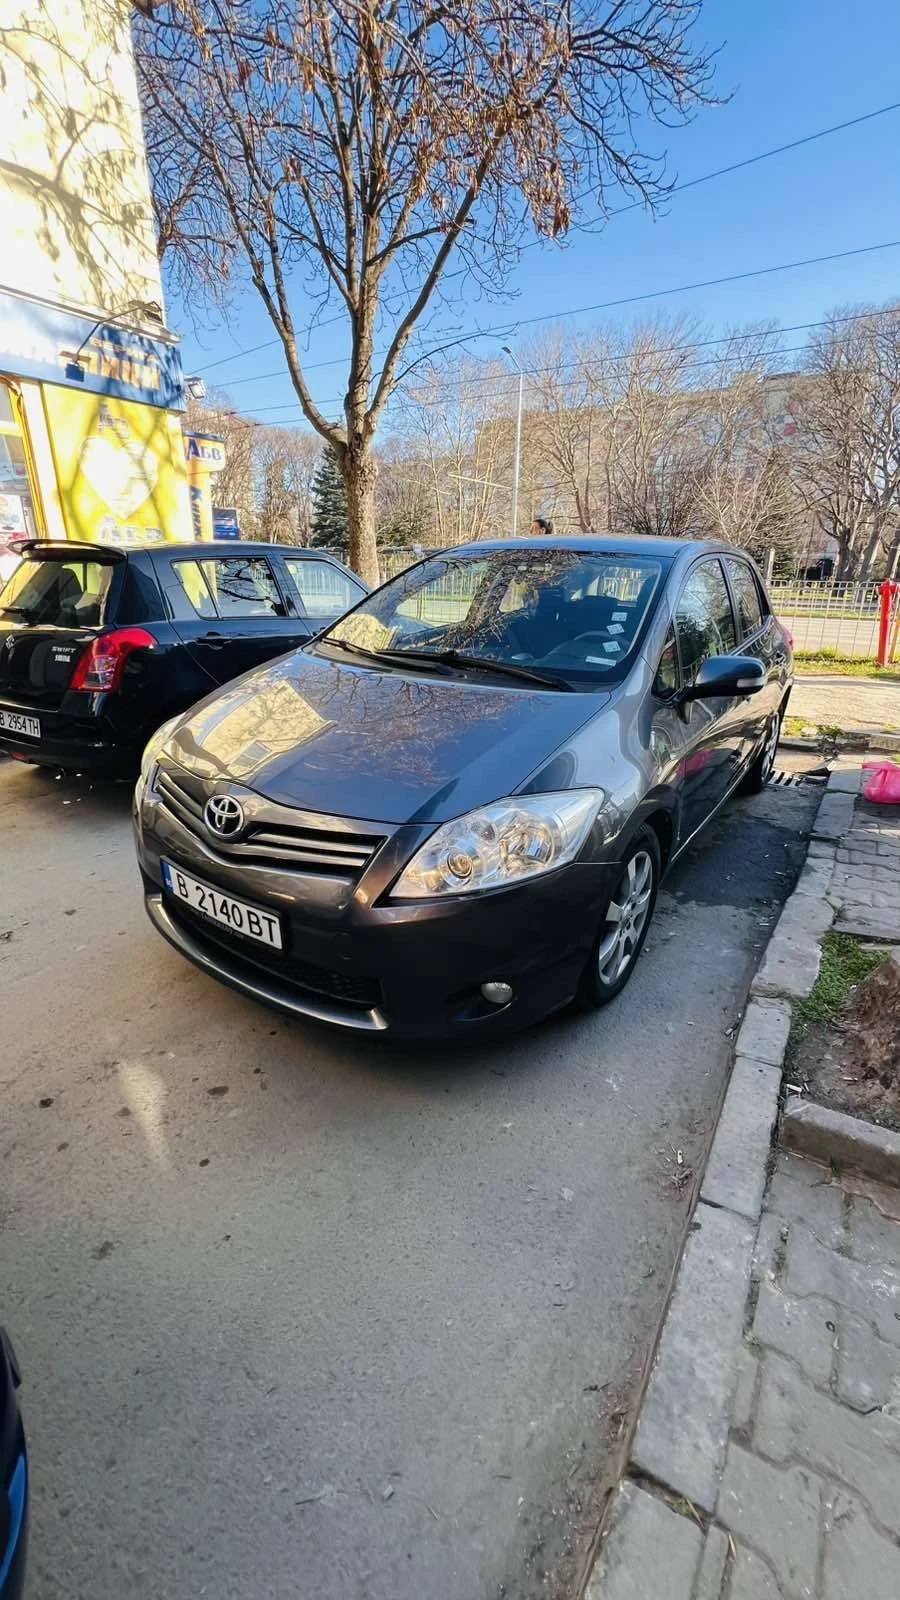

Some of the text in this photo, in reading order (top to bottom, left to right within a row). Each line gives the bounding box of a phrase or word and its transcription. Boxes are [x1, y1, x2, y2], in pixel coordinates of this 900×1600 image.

[176, 873, 189, 899] B
[195, 886, 243, 928] 2140
[247, 910, 276, 942] BT
